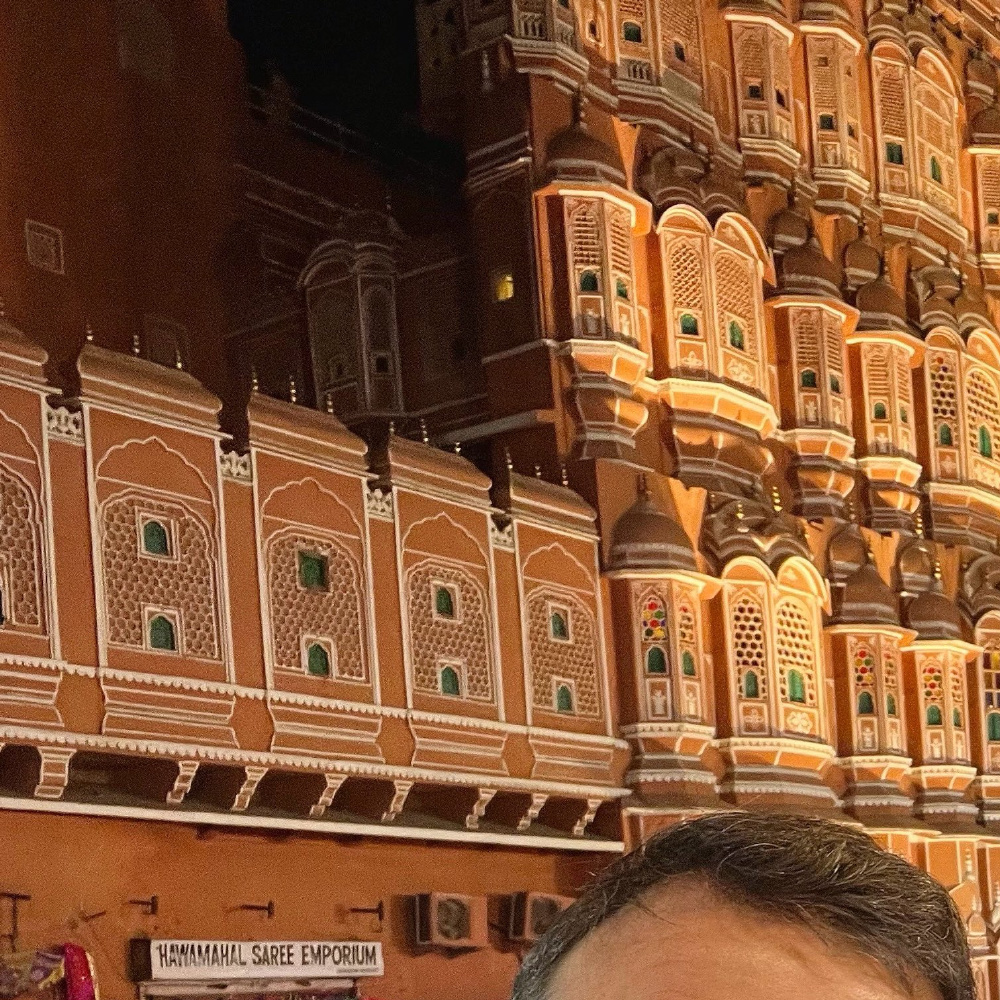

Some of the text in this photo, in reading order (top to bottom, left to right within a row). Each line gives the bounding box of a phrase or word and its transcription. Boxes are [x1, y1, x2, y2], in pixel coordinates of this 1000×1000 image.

[157, 943, 377, 967] HAWAMAHAL SAREE EMPORIUM
